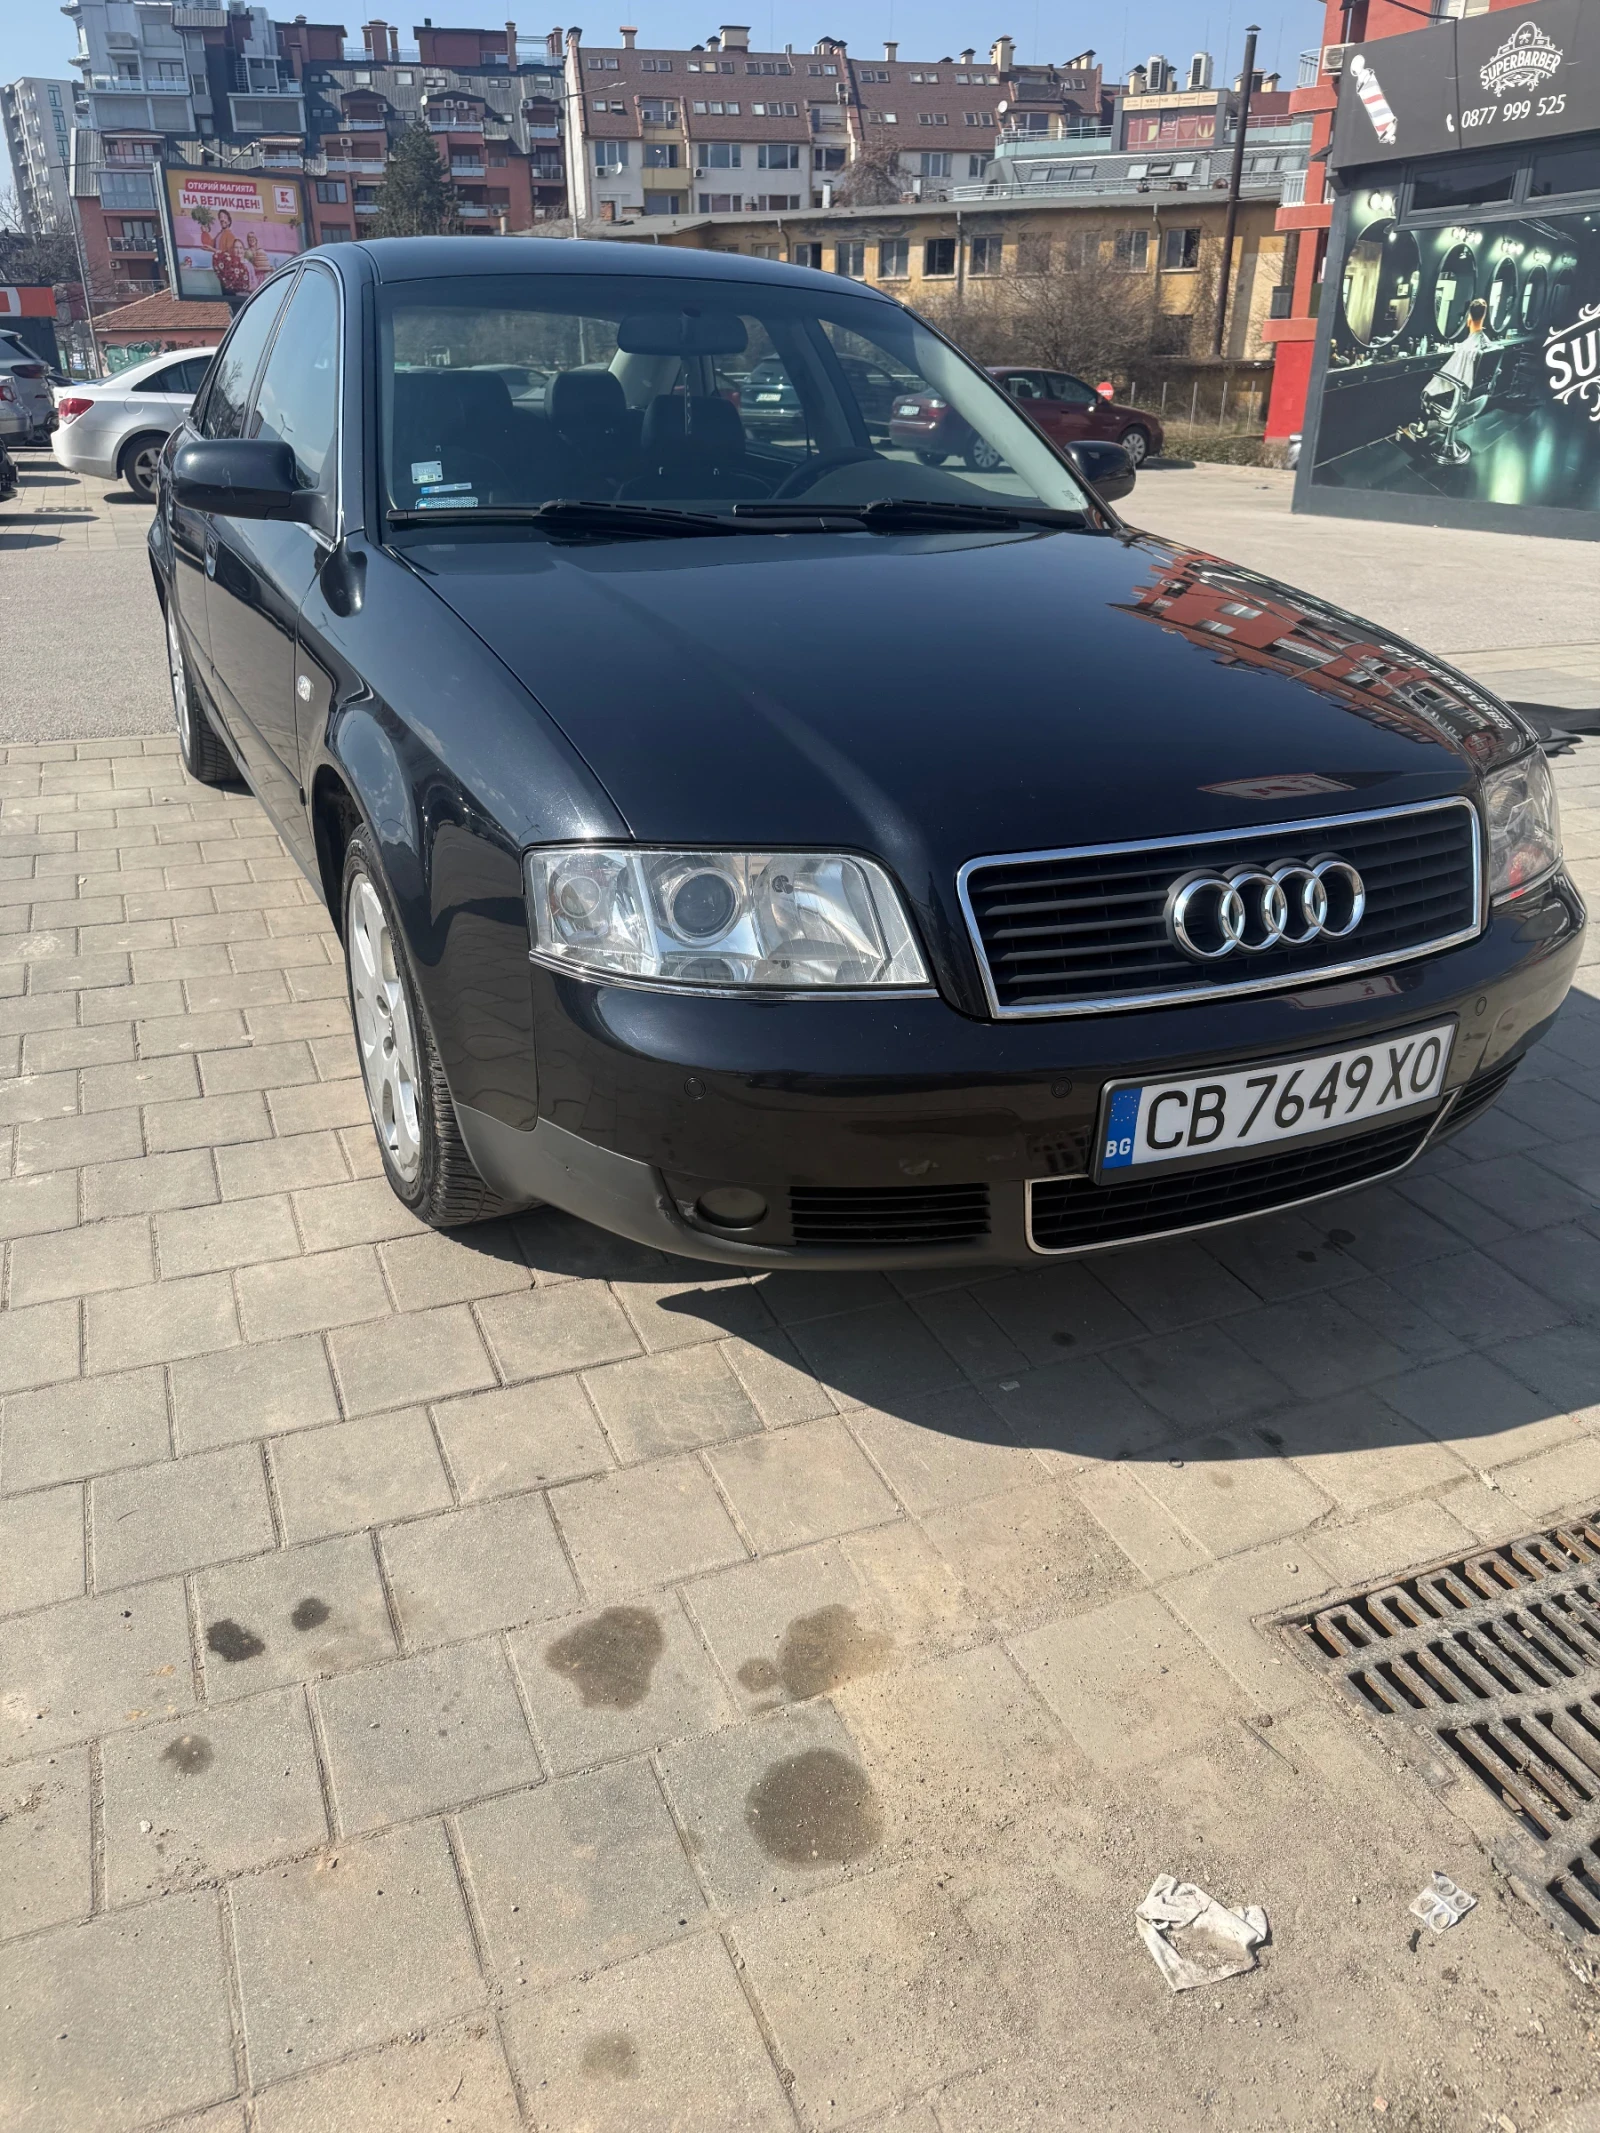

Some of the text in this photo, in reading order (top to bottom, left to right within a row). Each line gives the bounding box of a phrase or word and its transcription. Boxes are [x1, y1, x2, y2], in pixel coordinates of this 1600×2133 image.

[1480, 50, 1561, 86] SUPERBARBER
[1461, 94, 1567, 128] 0877 999 525
[183, 194, 199, 205] НА
[187, 181, 255, 194] ОТКРИЙ МАГИЯТА
[1545, 329, 1600, 390] SU
[1146, 1036, 1441, 1150] CB 7649 XO
[1105, 1137, 1131, 1158] BG
